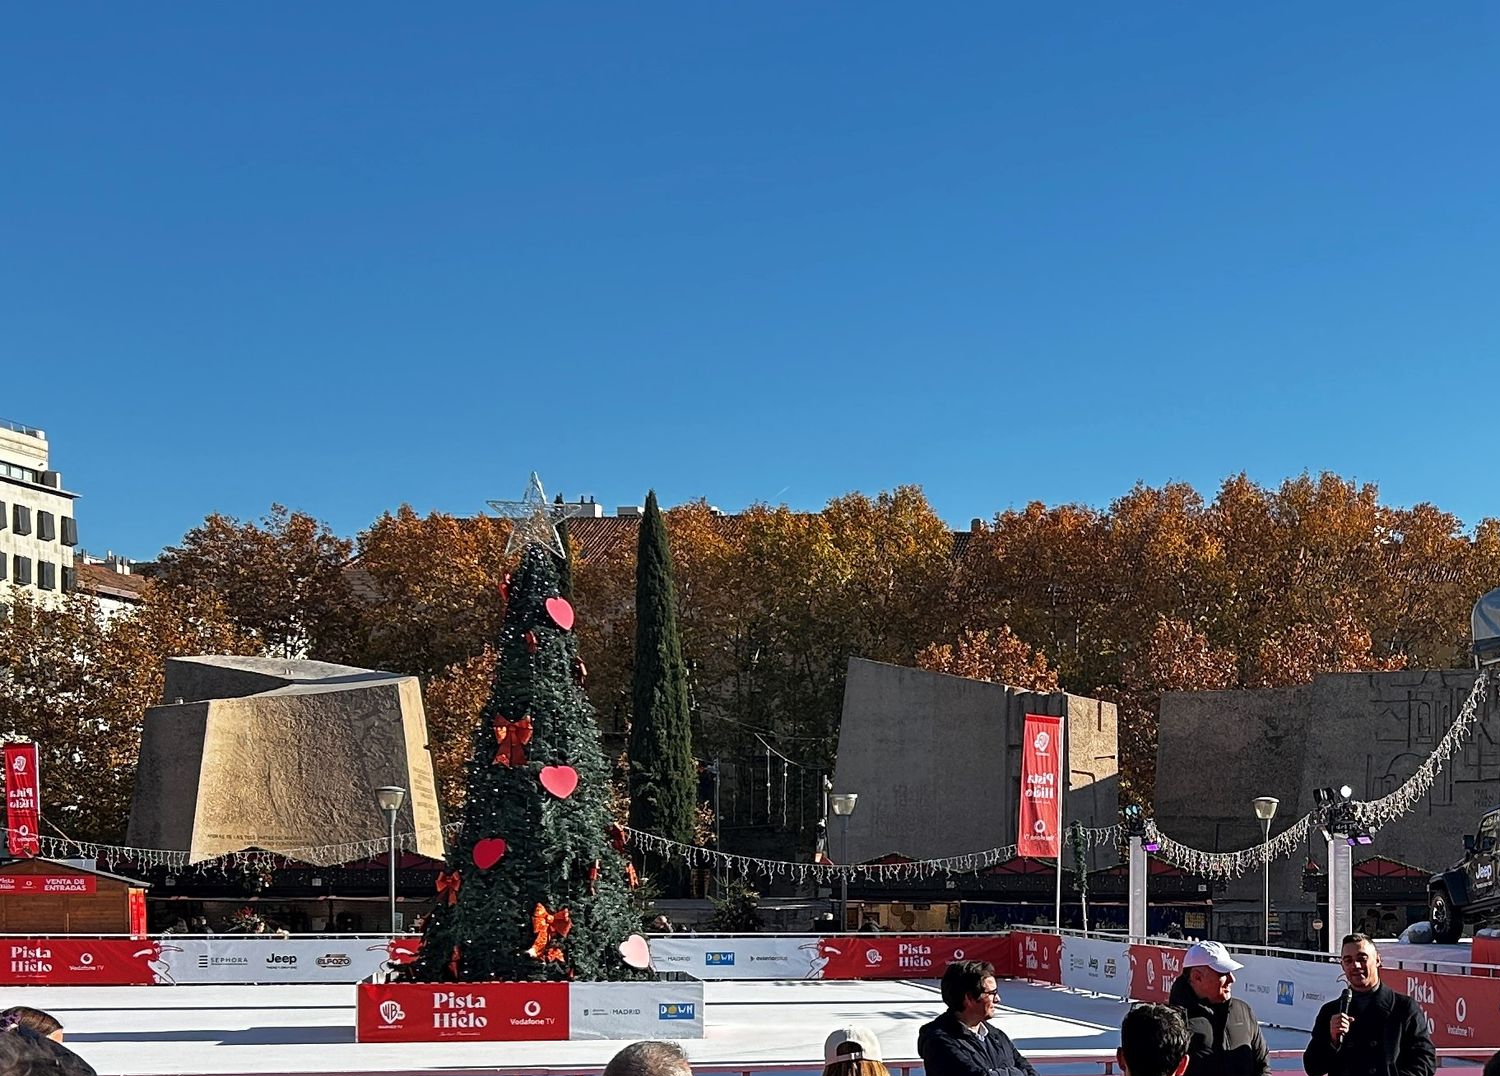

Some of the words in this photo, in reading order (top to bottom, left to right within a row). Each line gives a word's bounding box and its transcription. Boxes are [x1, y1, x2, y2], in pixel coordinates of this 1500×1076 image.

[1475, 864, 1493, 880] Jeep
[11, 946, 52, 959] Pista
[899, 943, 932, 955] Pista
[266, 953, 297, 965] Jeep
[899, 956, 932, 967] Hielo
[1161, 952, 1180, 971] Pista
[11, 960, 53, 973] Hielo
[1407, 977, 1435, 1004] Pista
[433, 991, 488, 1009] Pista
[612, 1008, 641, 1016] MADRID
[660, 1004, 694, 1015] DOWN
[433, 1012, 488, 1028] Hielo
[510, 1017, 546, 1026] Vodafone
[545, 1017, 556, 1026] TV
